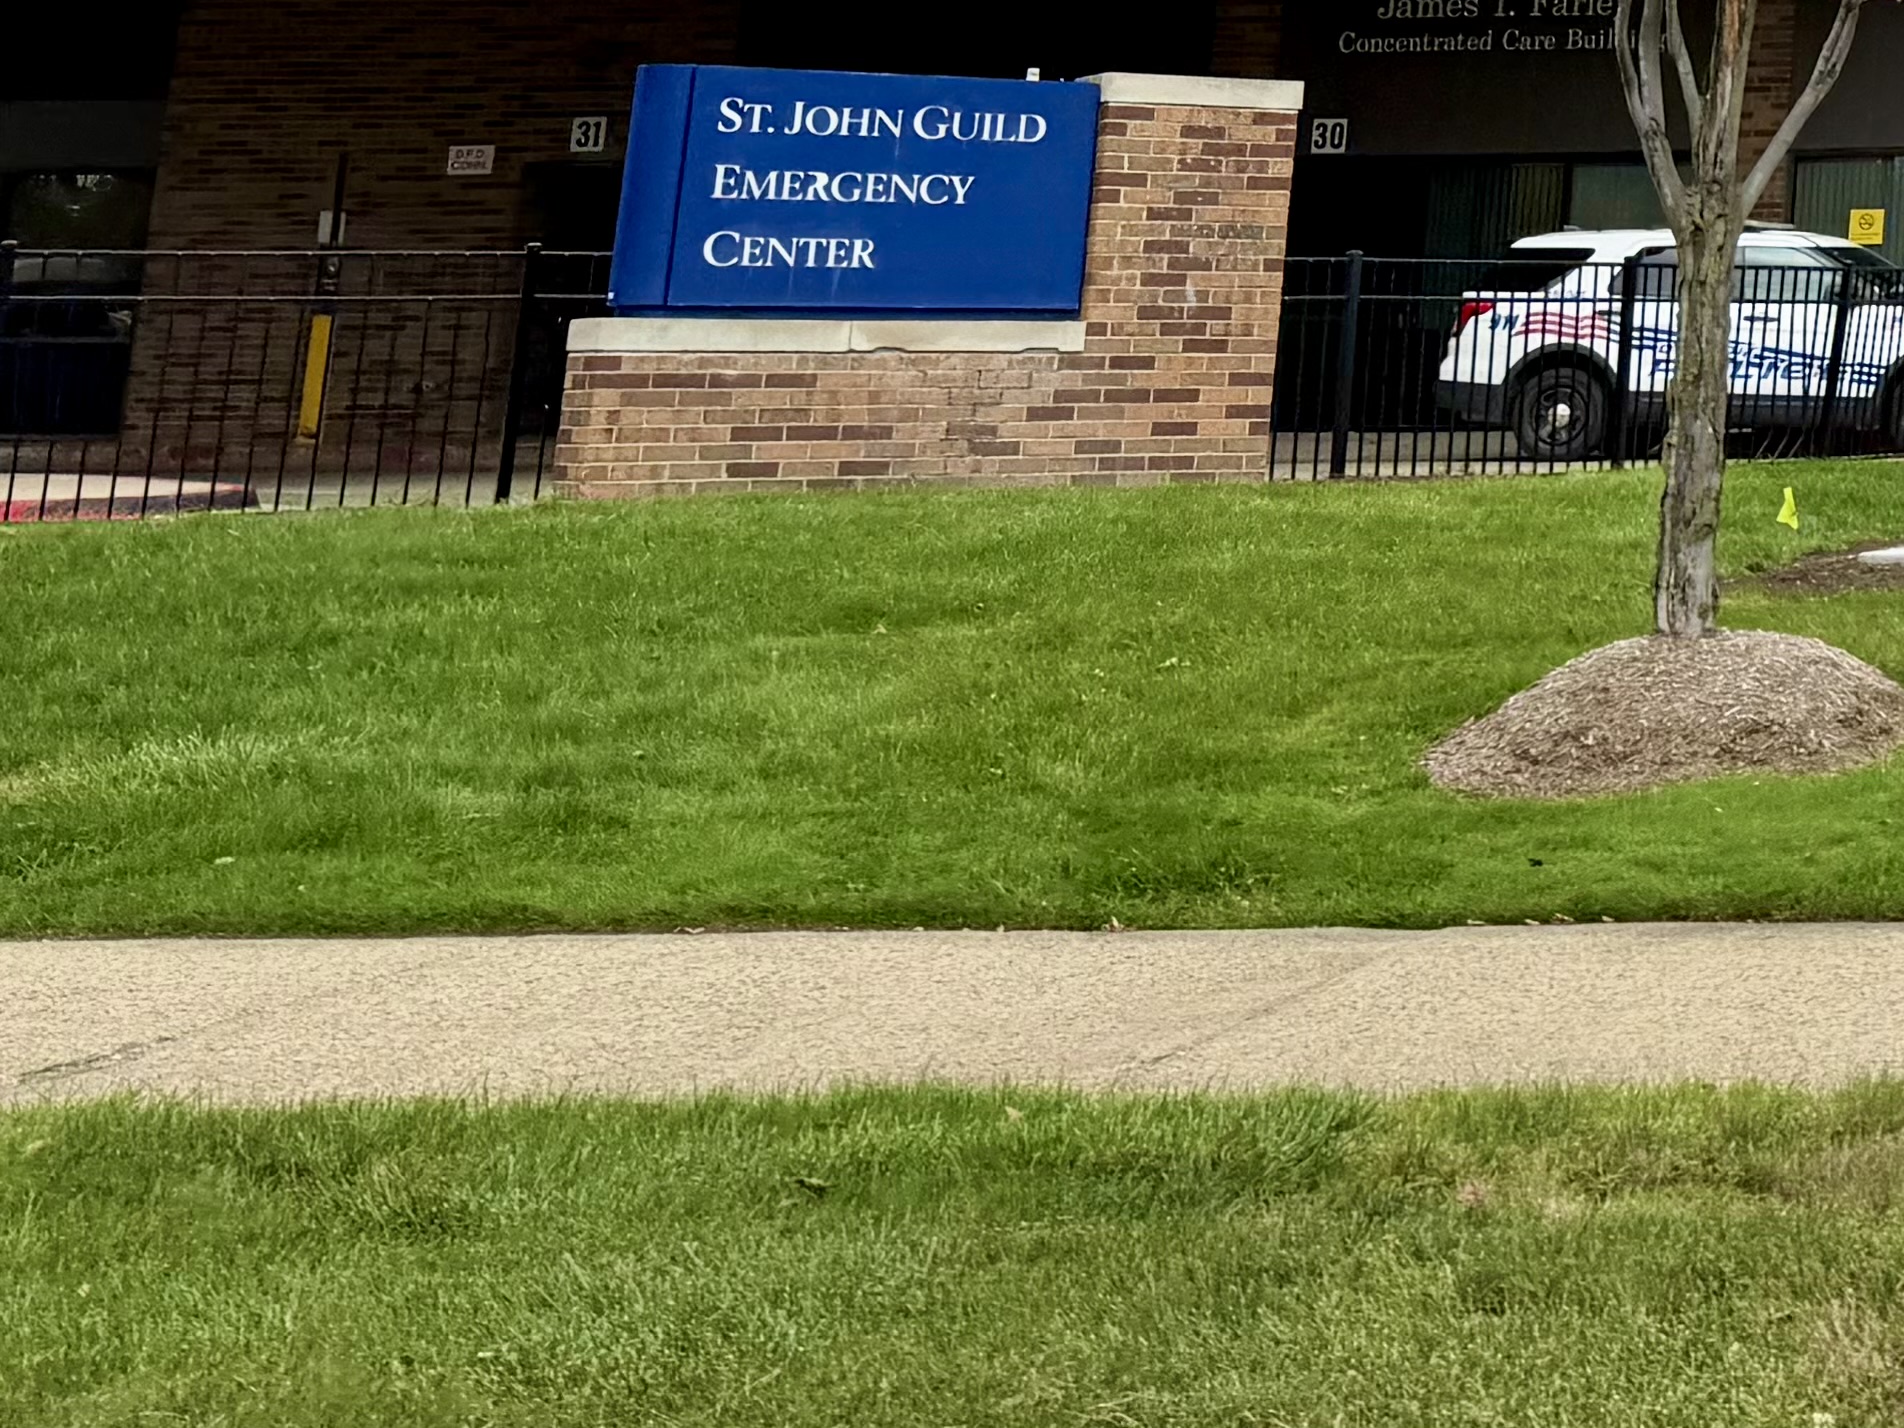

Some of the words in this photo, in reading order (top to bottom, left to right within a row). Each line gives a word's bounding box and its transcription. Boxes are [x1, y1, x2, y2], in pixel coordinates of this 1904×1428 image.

[1338, 29, 1493, 54] Concentrated
[1502, 28, 1557, 51] Care
[575, 120, 602, 148] 31
[784, 100, 905, 139] JOHN
[912, 104, 1048, 144] GUILD
[1313, 121, 1346, 150] 30
[709, 162, 977, 206] EMERGENCY
[702, 230, 876, 270] CENTER
